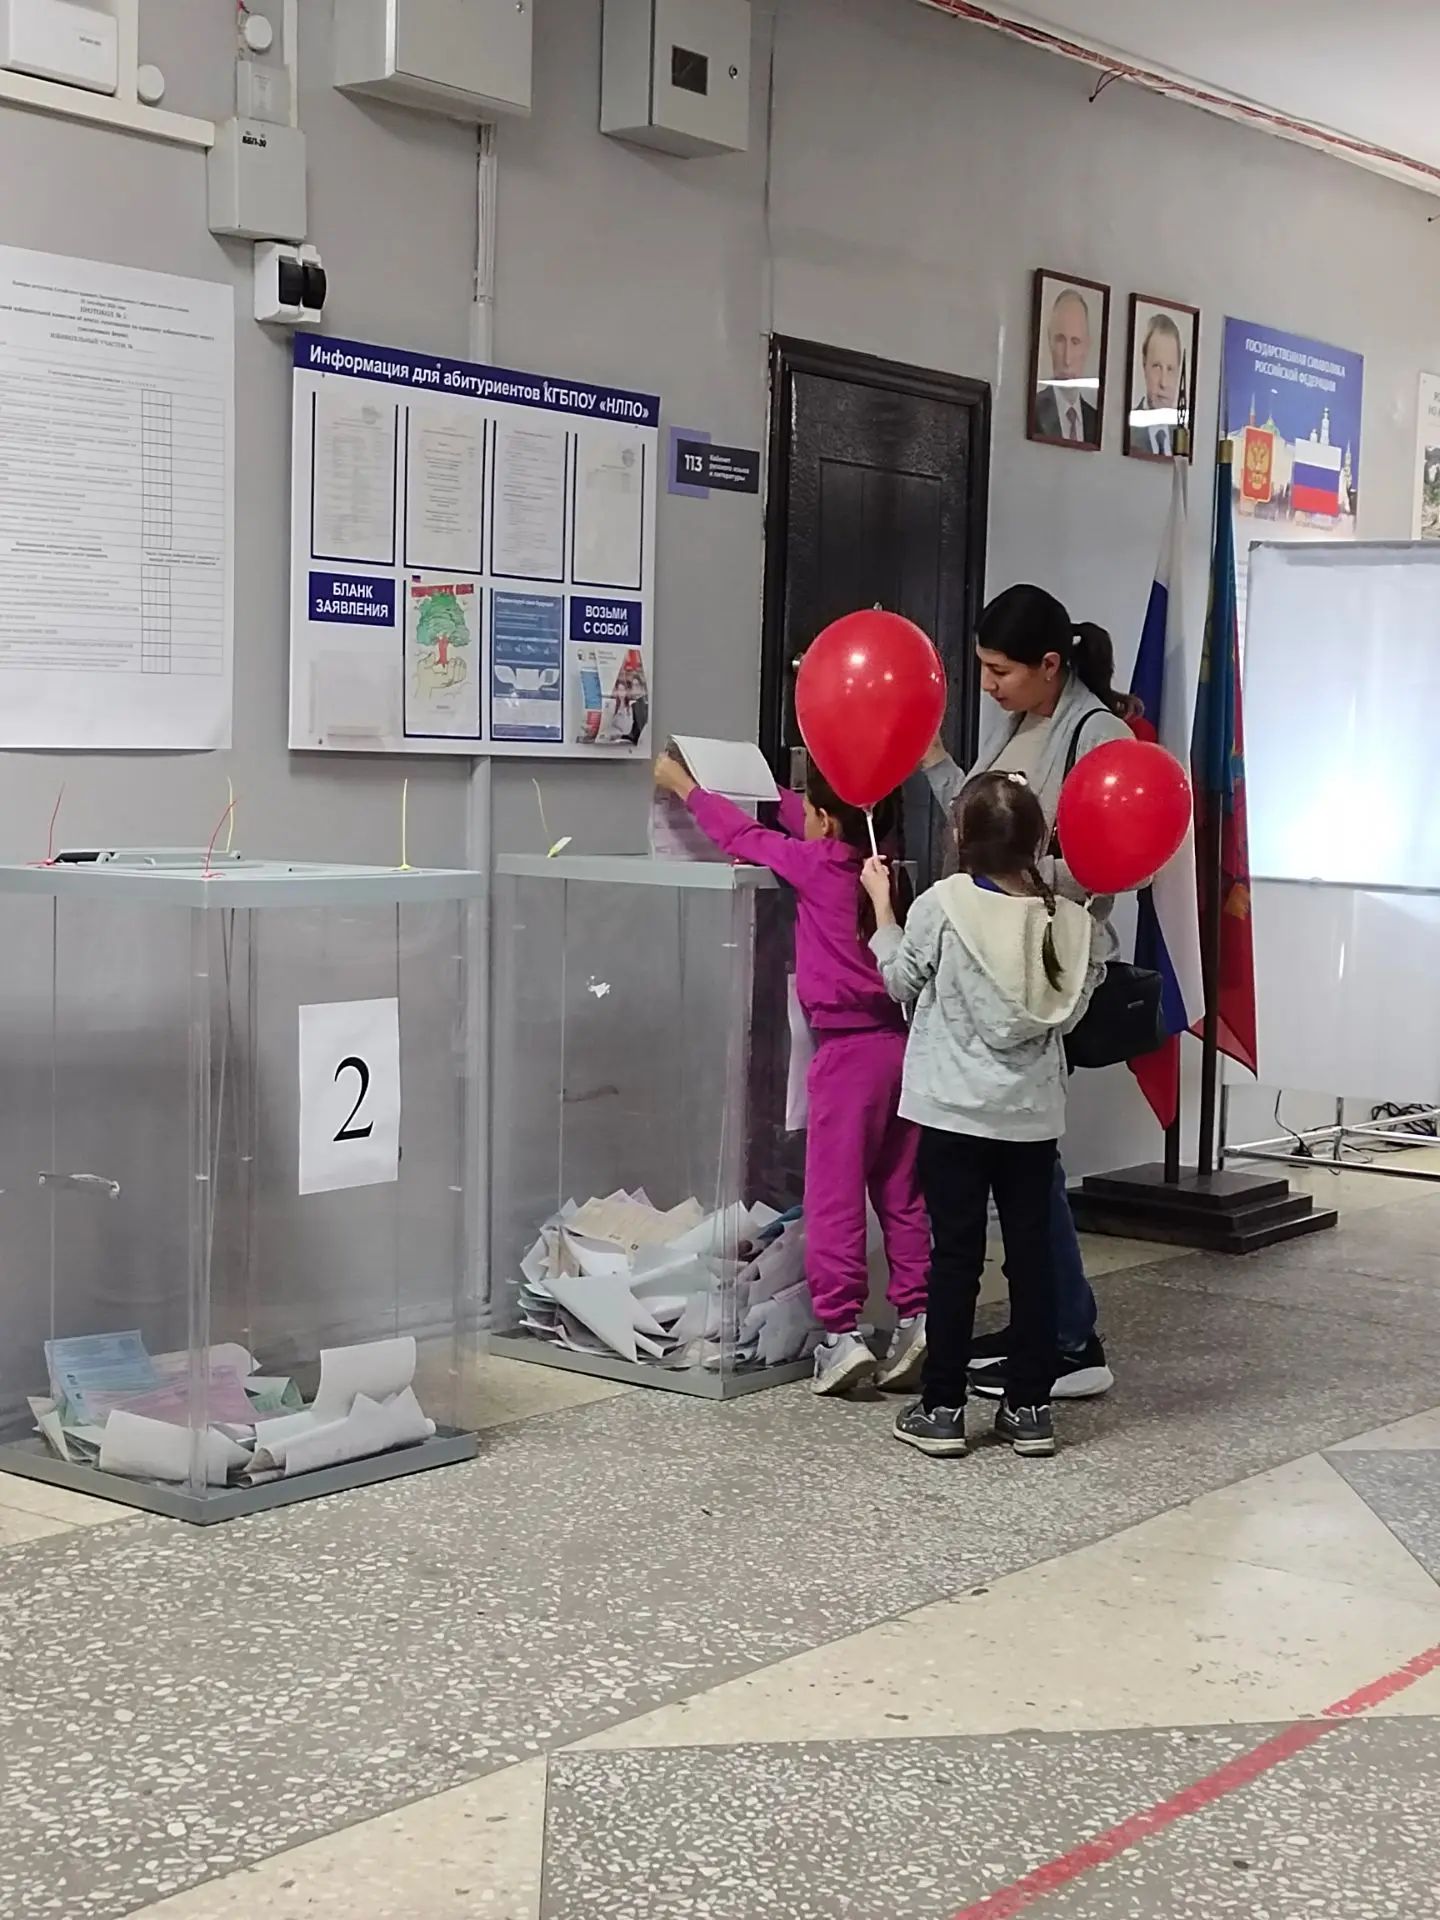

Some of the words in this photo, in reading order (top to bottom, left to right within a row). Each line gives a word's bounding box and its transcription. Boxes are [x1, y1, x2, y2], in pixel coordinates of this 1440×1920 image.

[1245, 338, 1307, 366] ГОСУДАРСТВЕННАЯ
[310, 344, 409, 379] Информация
[412, 366, 440, 384] для
[443, 371, 541, 400] абитуриентов
[544, 386, 597, 410] КГБПОУ
[1254, 359, 1299, 382] РОССИЙСКОЙ
[684, 453, 703, 472] 113
[332, 582, 374, 599] БЛАНК
[315, 598, 389, 618] ЗАЯВЛЕНИЯ
[585, 604, 628, 621] ВОЗЬМИ
[583, 621, 591, 634] С
[593, 621, 629, 637] СОБОЙ
[333, 1056, 374, 1142] 2
